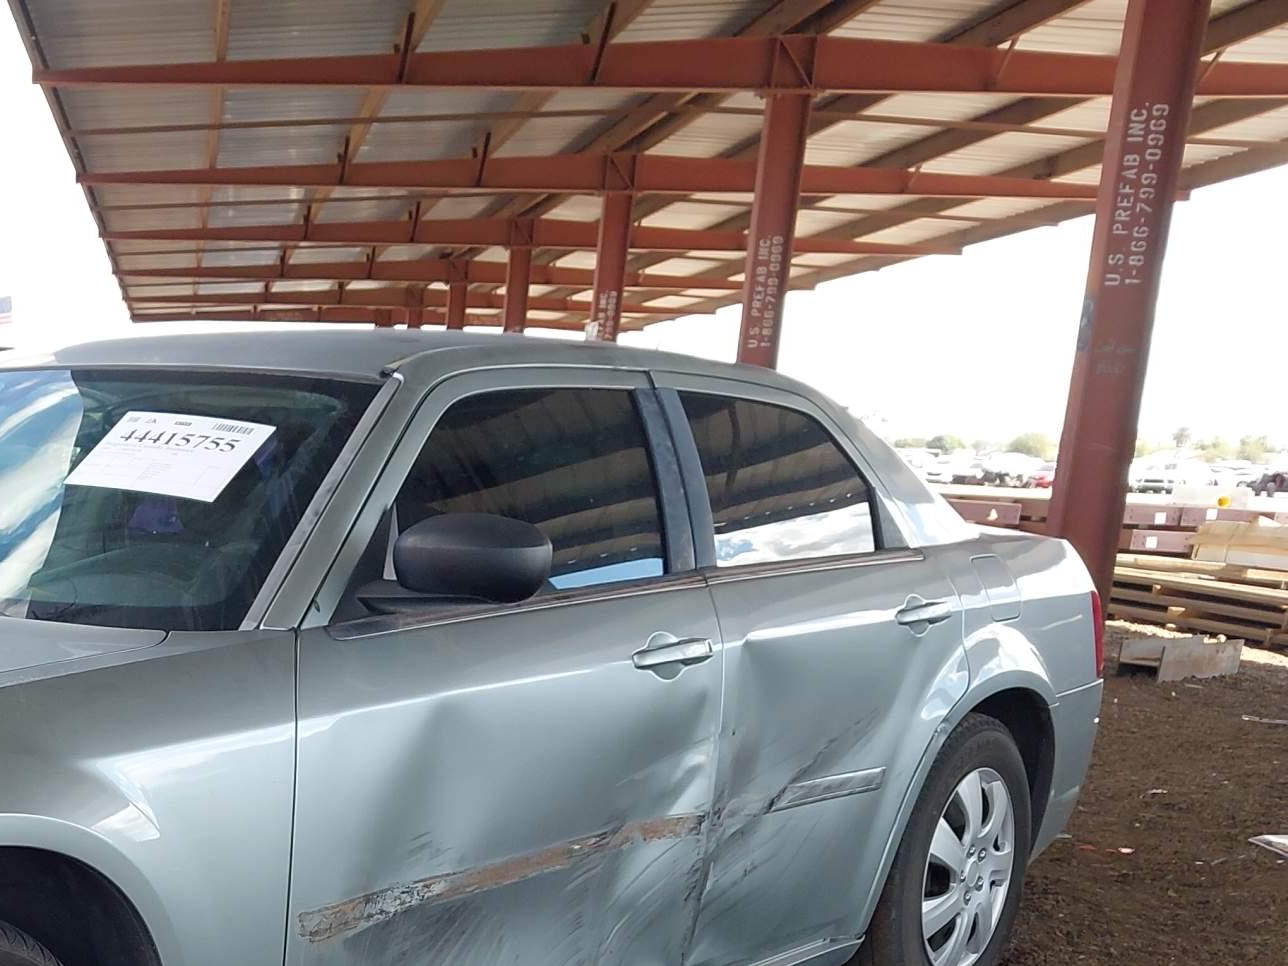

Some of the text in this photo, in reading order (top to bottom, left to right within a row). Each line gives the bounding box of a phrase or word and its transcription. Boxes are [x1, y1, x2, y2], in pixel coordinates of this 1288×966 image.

[1112, 154, 1140, 234] PREFAB
[1127, 101, 1150, 142] INC.
[751, 266, 767, 317] PREFAB
[120, 428, 241, 453] 44415755
